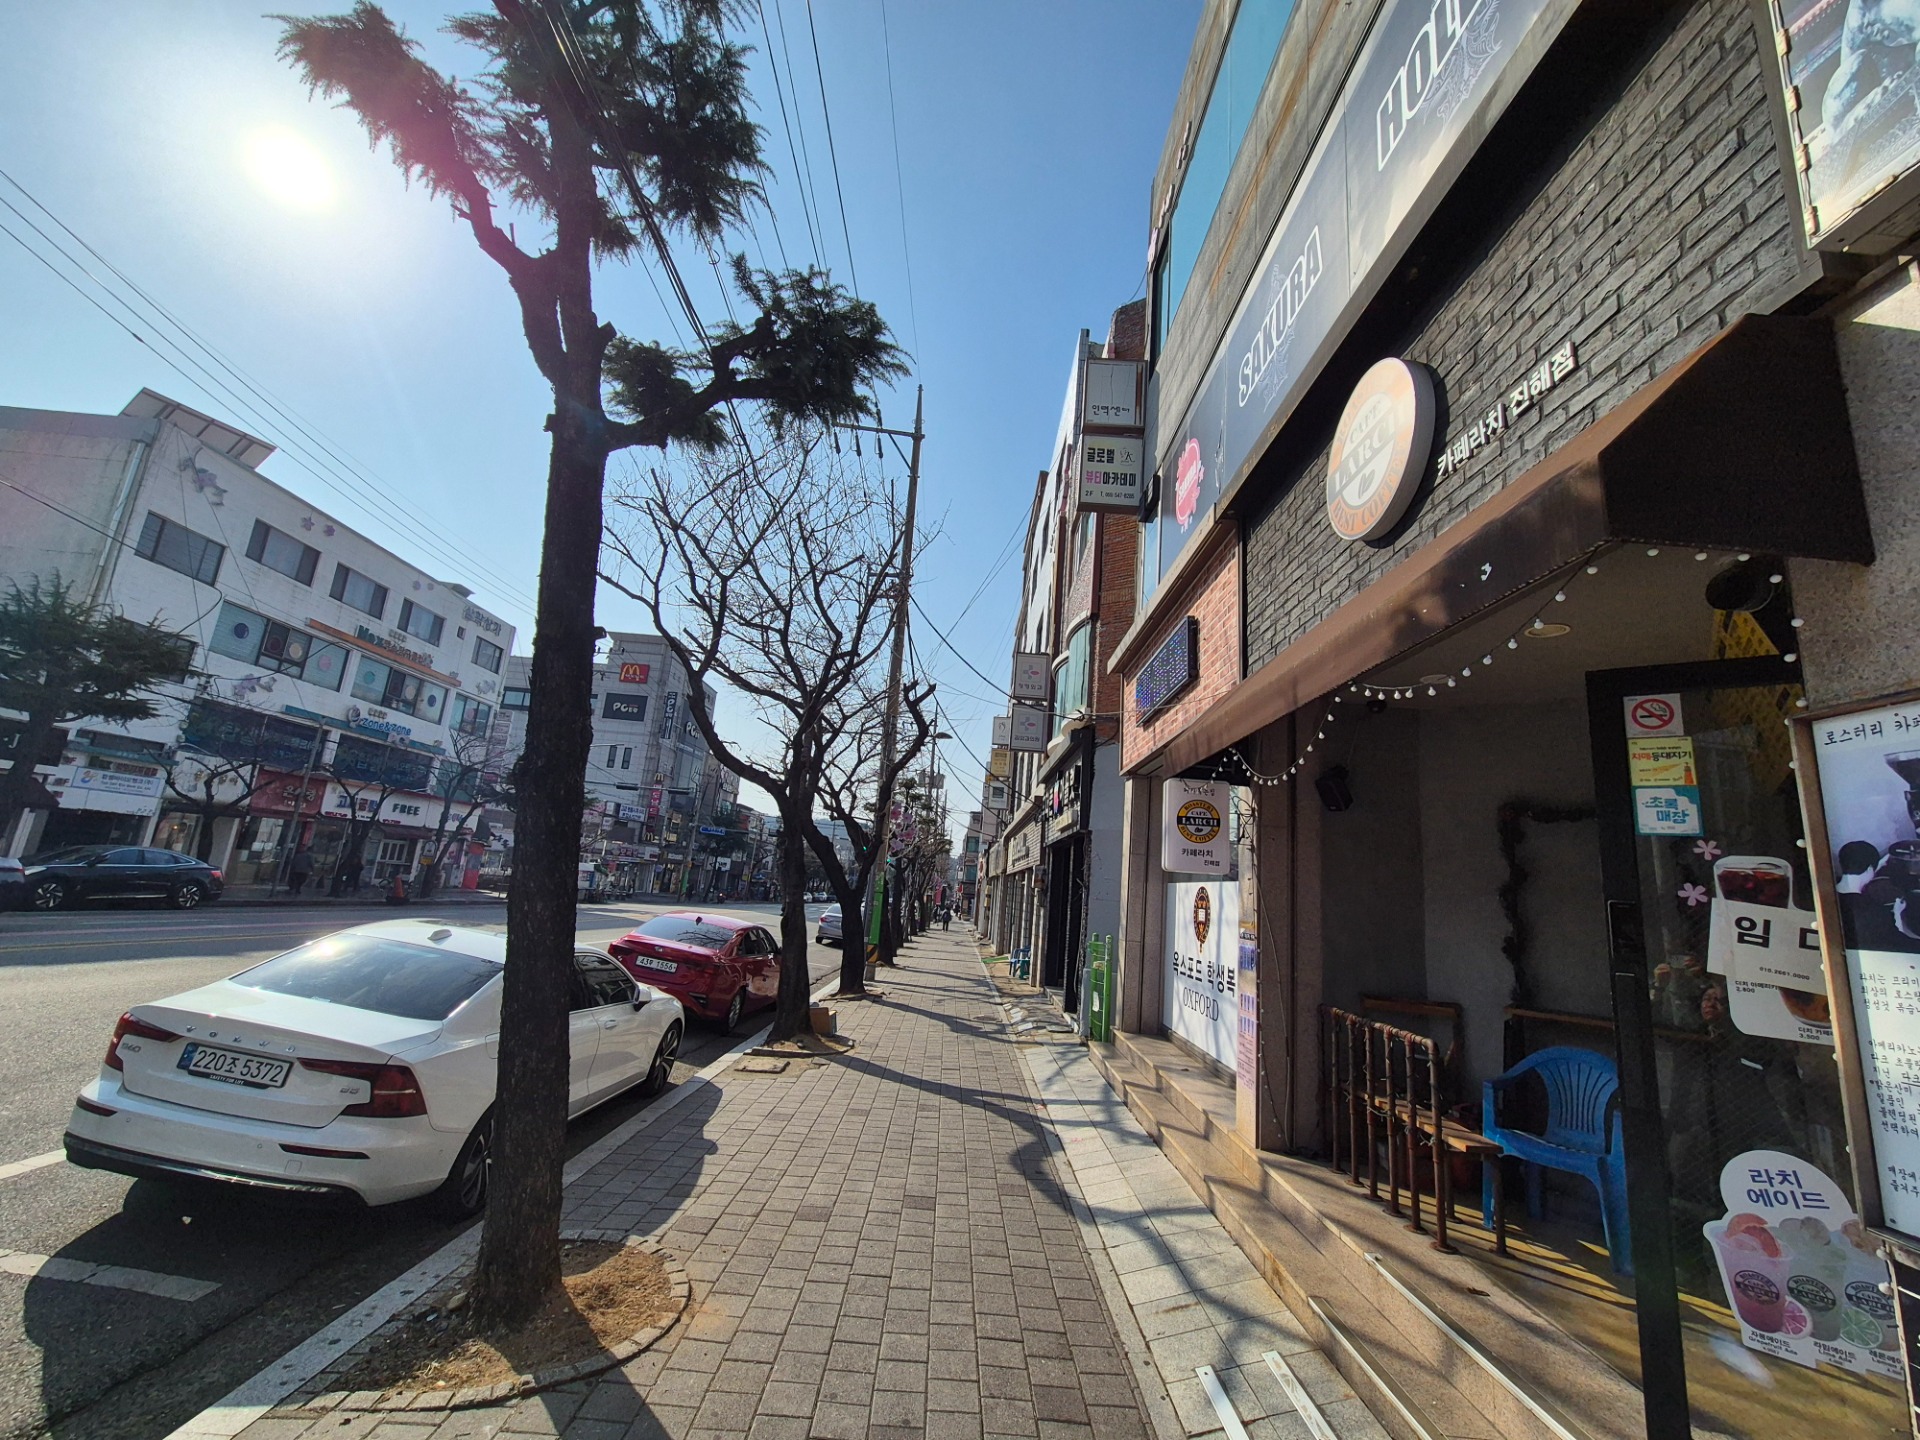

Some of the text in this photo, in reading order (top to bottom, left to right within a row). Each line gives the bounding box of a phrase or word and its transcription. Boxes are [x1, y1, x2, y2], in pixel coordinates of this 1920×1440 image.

[1239, 225, 1323, 407] SAKURA
[1092, 404, 1130, 417] 인력센터
[1437, 402, 1506, 476] 카페라치
[1509, 341, 1577, 417] 진해점
[1087, 447, 1115, 464] 글로벌
[1085, 470, 1136, 487] 뷰티아카데미
[1823, 720, 1884, 746] 로스터리
[392, 803, 421, 816] FREE
[1656, 809, 1690, 824] 매장
[1182, 817, 1218, 826] LARCH
[1181, 848, 1213, 857] 카페라치
[1173, 951, 1203, 982] 옥스포드
[1207, 960, 1236, 998] 학생복
[1183, 987, 1219, 1022] OXFORD
[185, 1025, 296, 1053] VOLVO
[192, 1050, 285, 1083] 220조 5372
[1748, 1169, 1803, 1189] 라치
[1746, 1189, 1830, 1210] 에이드
[1750, 1330, 1791, 1349] 자몽에이드
[1813, 1341, 1857, 1360] 라임에이드
